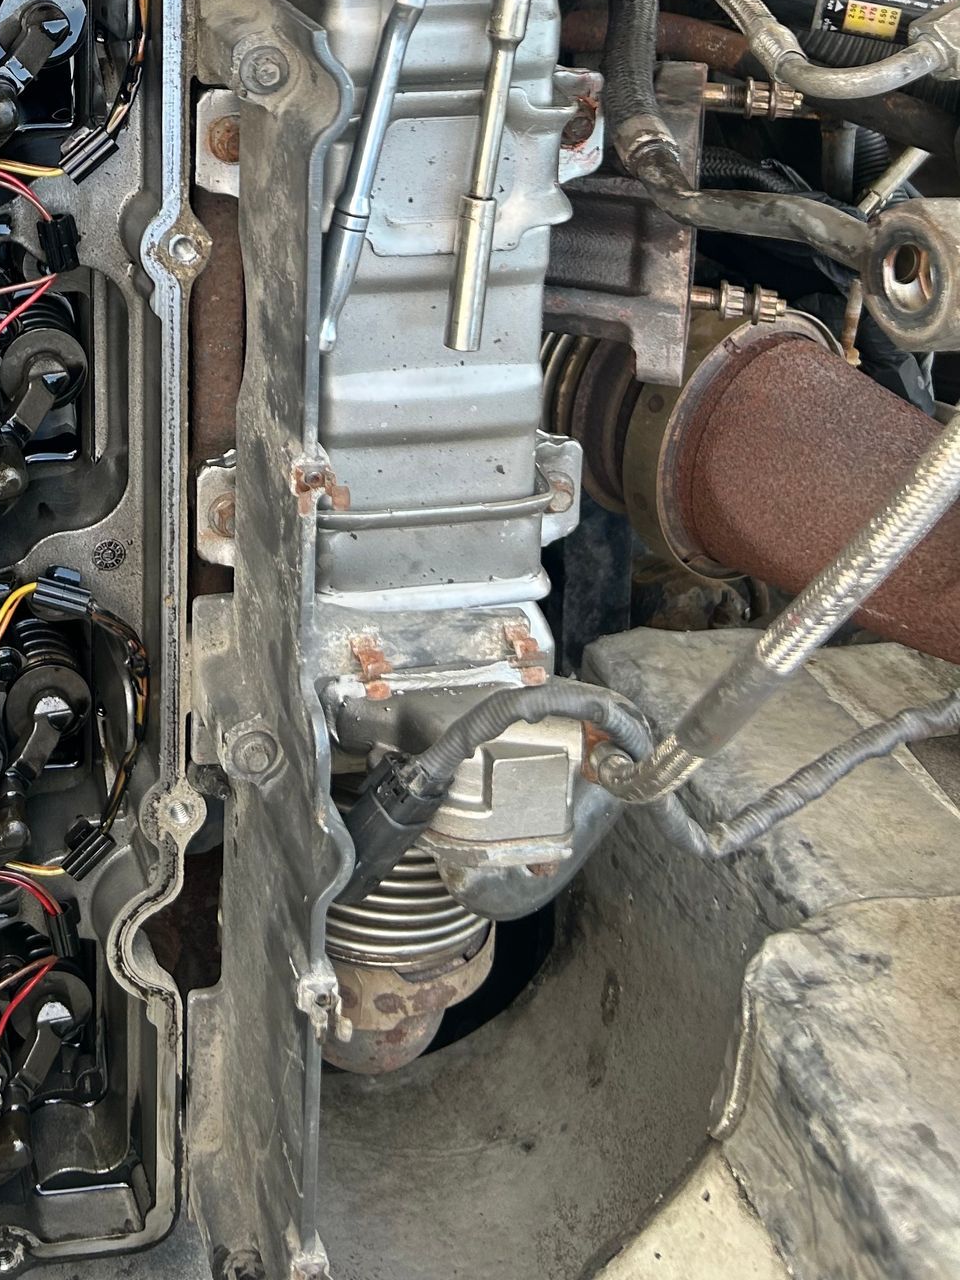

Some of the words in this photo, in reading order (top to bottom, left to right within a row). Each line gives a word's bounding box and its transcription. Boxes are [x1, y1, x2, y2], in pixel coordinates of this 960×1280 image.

[848, 3, 858, 19] 2.50
[878, 9, 888, 24] 5.50
[888, 10, 899, 26] 6.20
